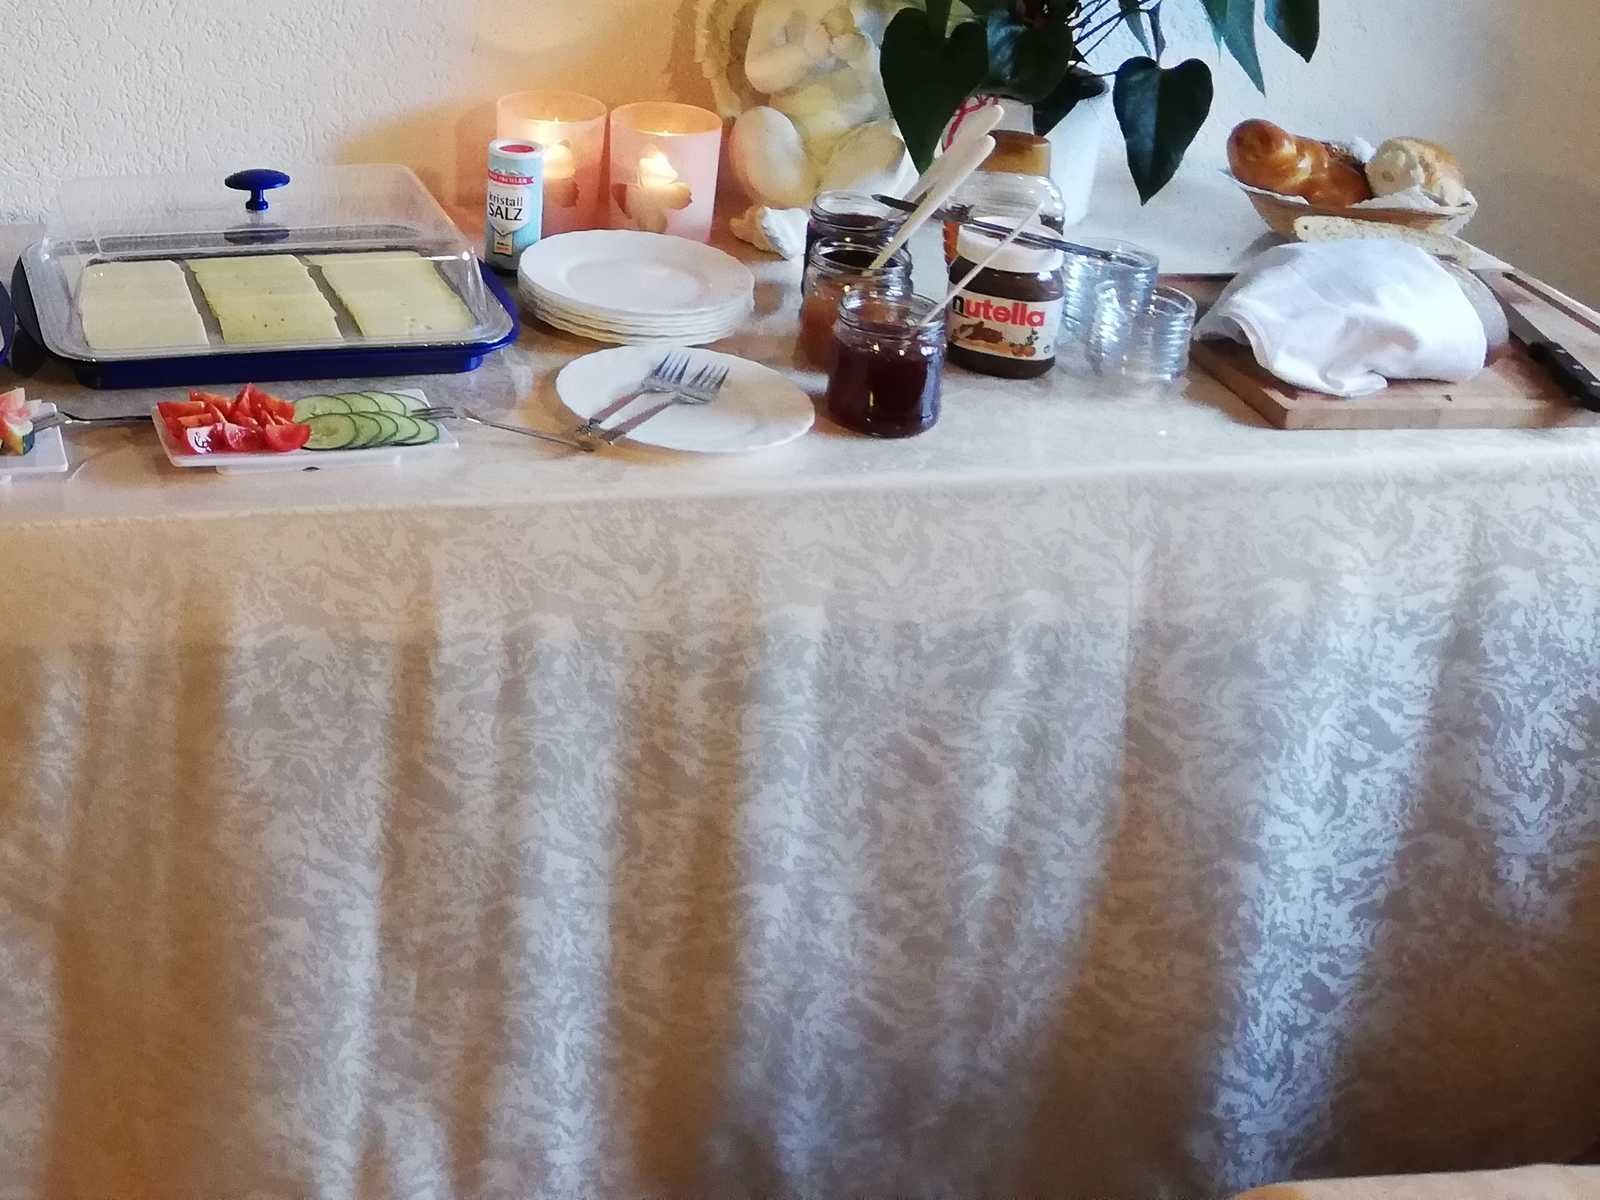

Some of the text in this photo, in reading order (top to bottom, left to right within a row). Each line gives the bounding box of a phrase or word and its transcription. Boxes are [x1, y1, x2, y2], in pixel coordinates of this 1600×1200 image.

[489, 191, 523, 207] kristall
[488, 203, 523, 221] SALZ
[951, 294, 1045, 327] nutella
